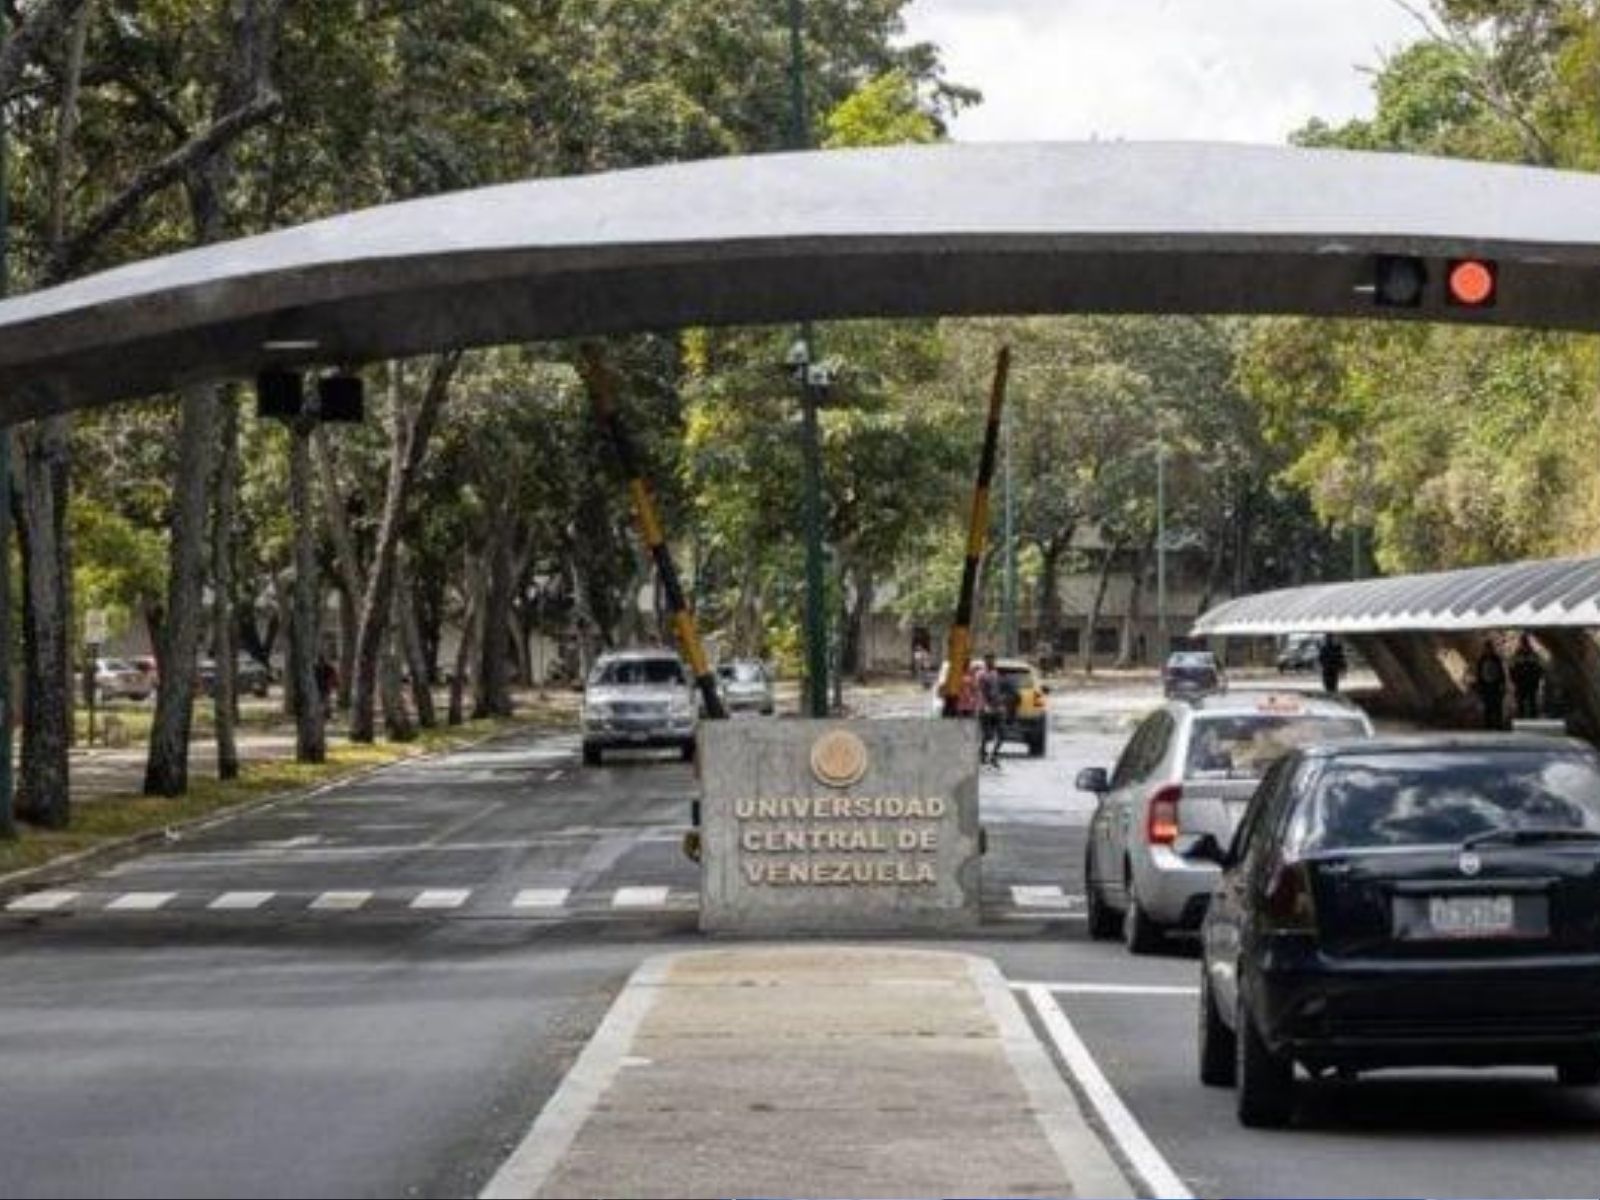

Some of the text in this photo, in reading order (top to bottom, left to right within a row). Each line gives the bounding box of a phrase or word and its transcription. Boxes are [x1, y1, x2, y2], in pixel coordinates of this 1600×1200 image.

[735, 797, 945, 819] UNIVERSIDAD
[743, 828, 938, 851] CENTRAL DE
[746, 860, 937, 885] VENEZUELA
